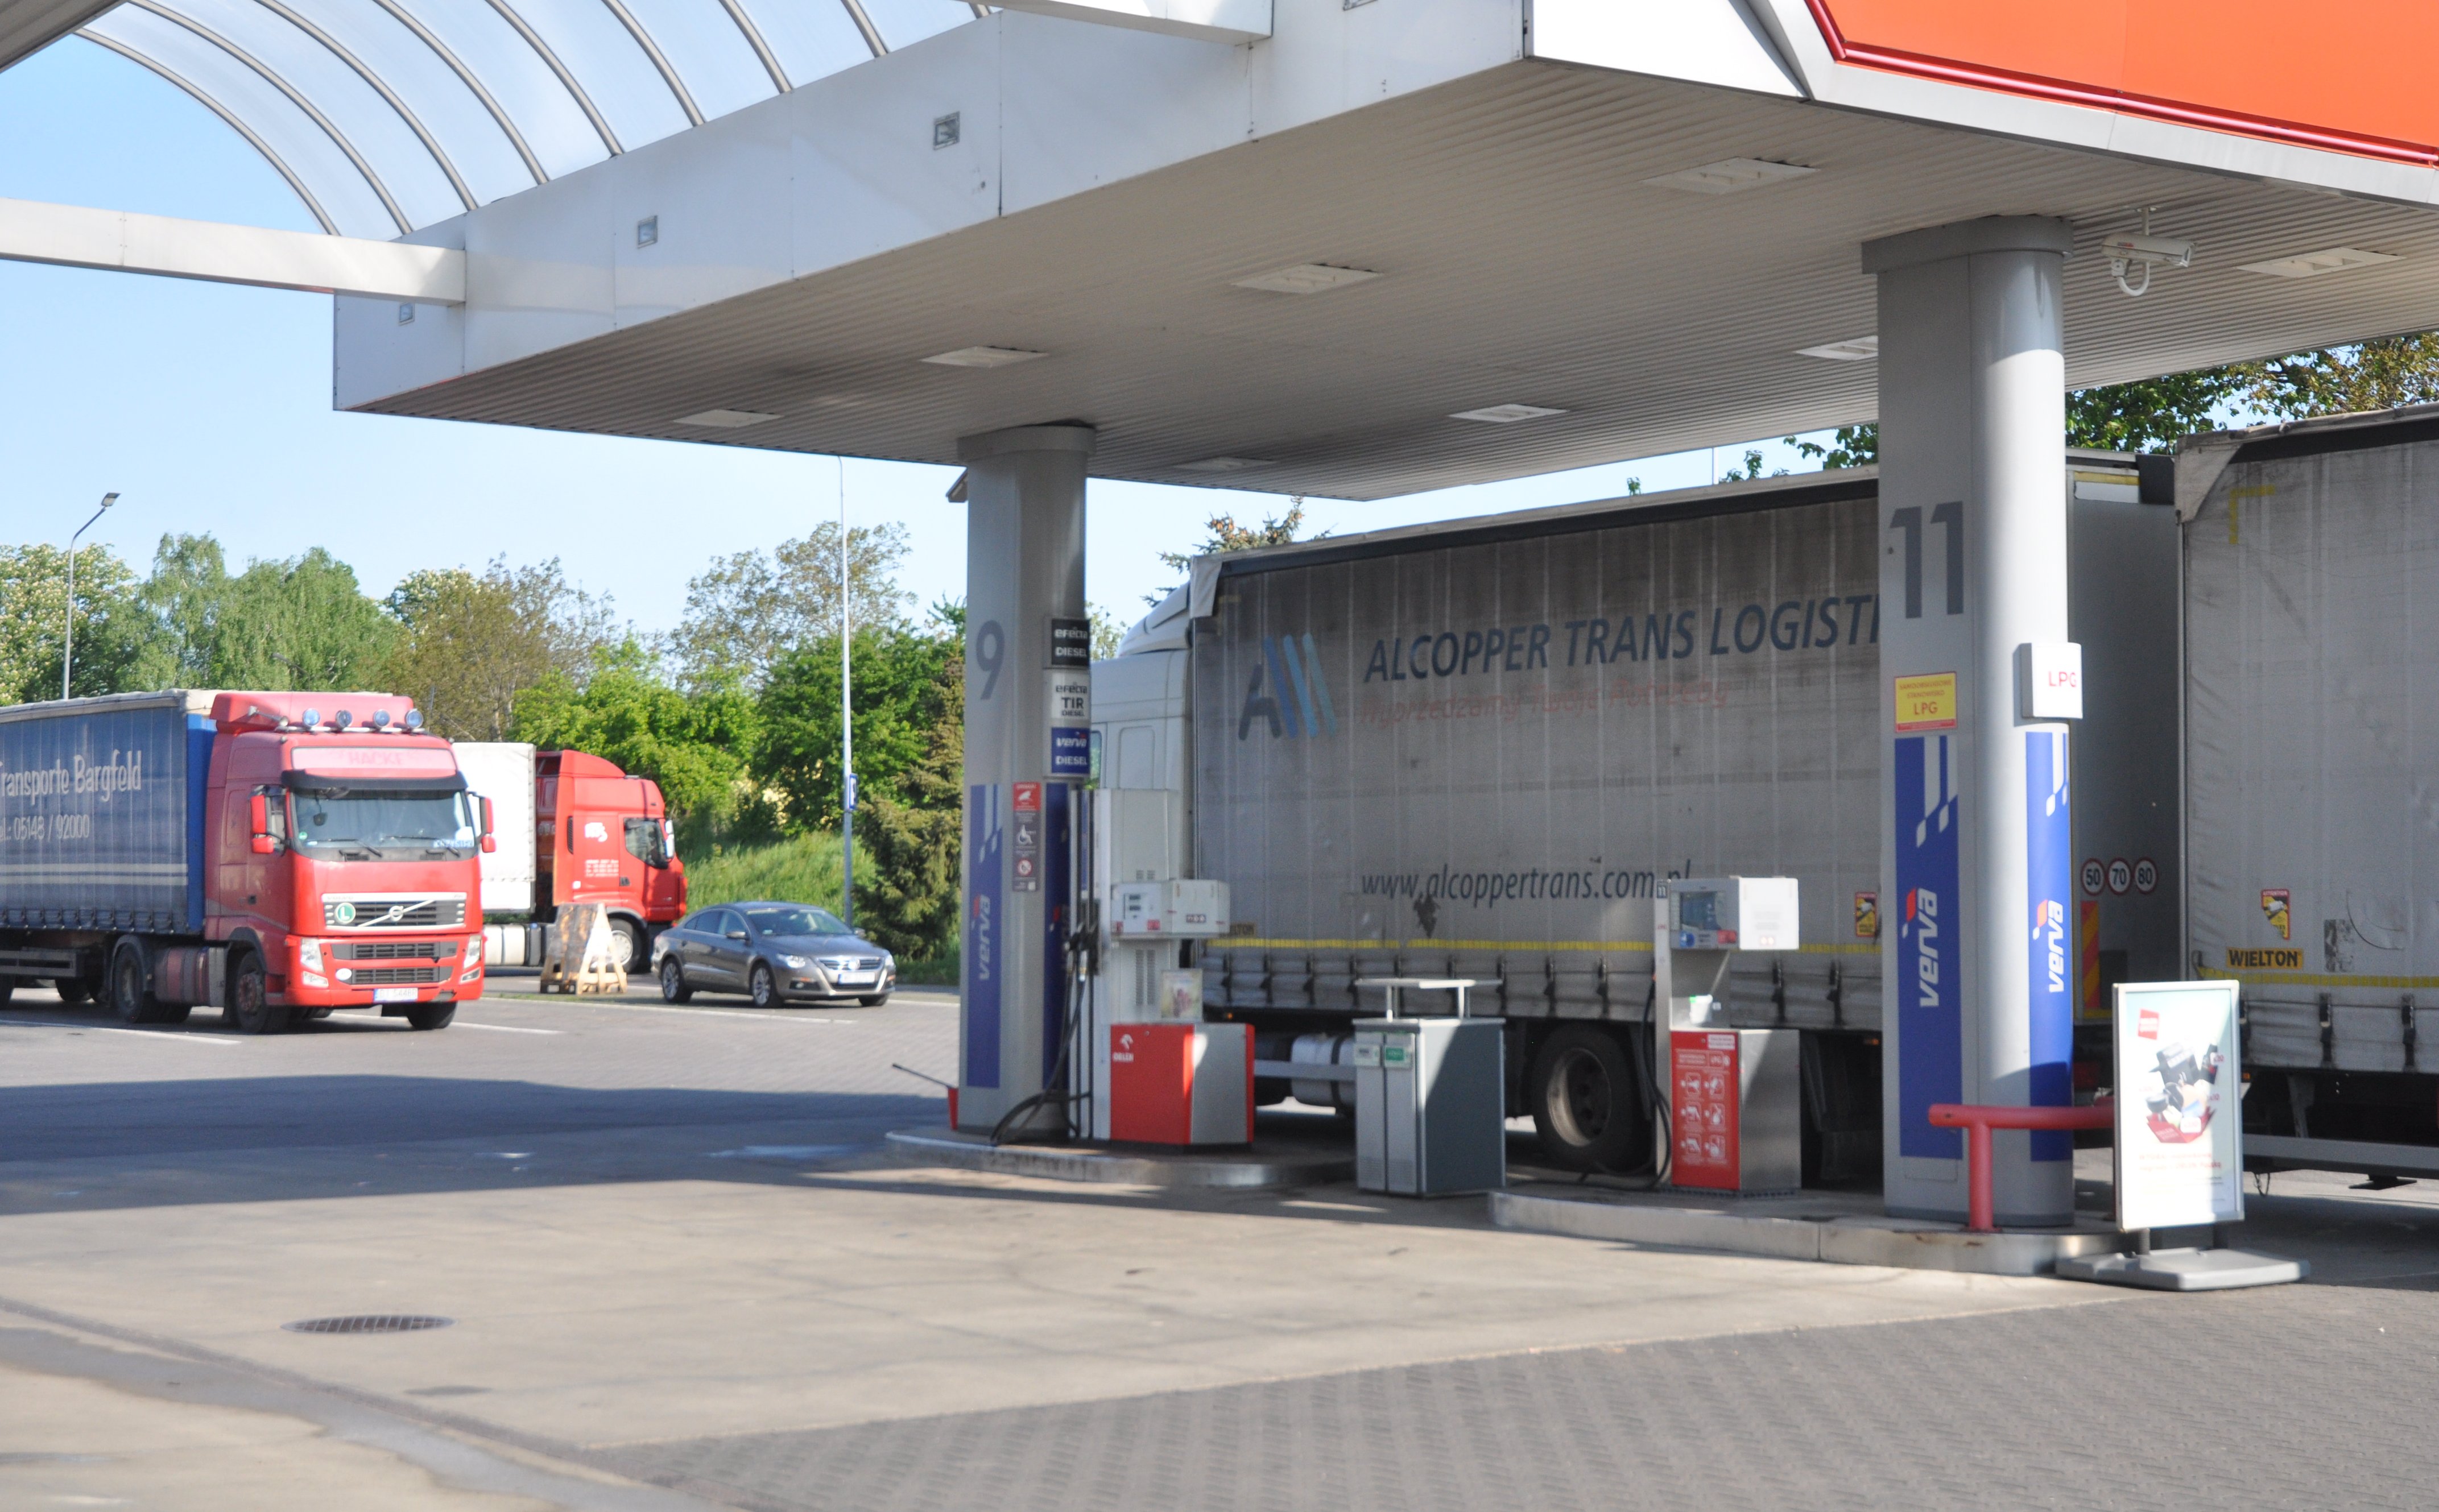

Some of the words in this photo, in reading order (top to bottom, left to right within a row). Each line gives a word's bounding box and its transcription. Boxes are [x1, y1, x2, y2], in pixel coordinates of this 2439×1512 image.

[1890, 500, 1965, 619] 11
[1055, 647, 1086, 656] DIESEL
[1363, 623, 1551, 682] ALCOPPER
[1565, 610, 1696, 666] TRANS
[976, 620, 1004, 700] 9
[2048, 672, 2077, 687] LPG
[1061, 697, 1084, 710] TIR
[1914, 701, 1938, 715] LPG
[1055, 756, 1087, 765] DIESEL
[0, 759, 69, 805] ransporte
[74, 749, 142, 802] Bargfeld
[14, 815, 44, 840] 05148
[56, 814, 90, 839] 92000
[1362, 859, 1691, 909] www.alcoppertrans.coml
[2086, 868, 2101, 886] 50
[2112, 868, 2127, 885] 70
[2138, 867, 2153, 884] 80
[979, 894, 990, 980] verva
[1917, 888, 1939, 1007] verva
[2048, 900, 2064, 993] verva
[2229, 949, 2299, 967] WIELTON
